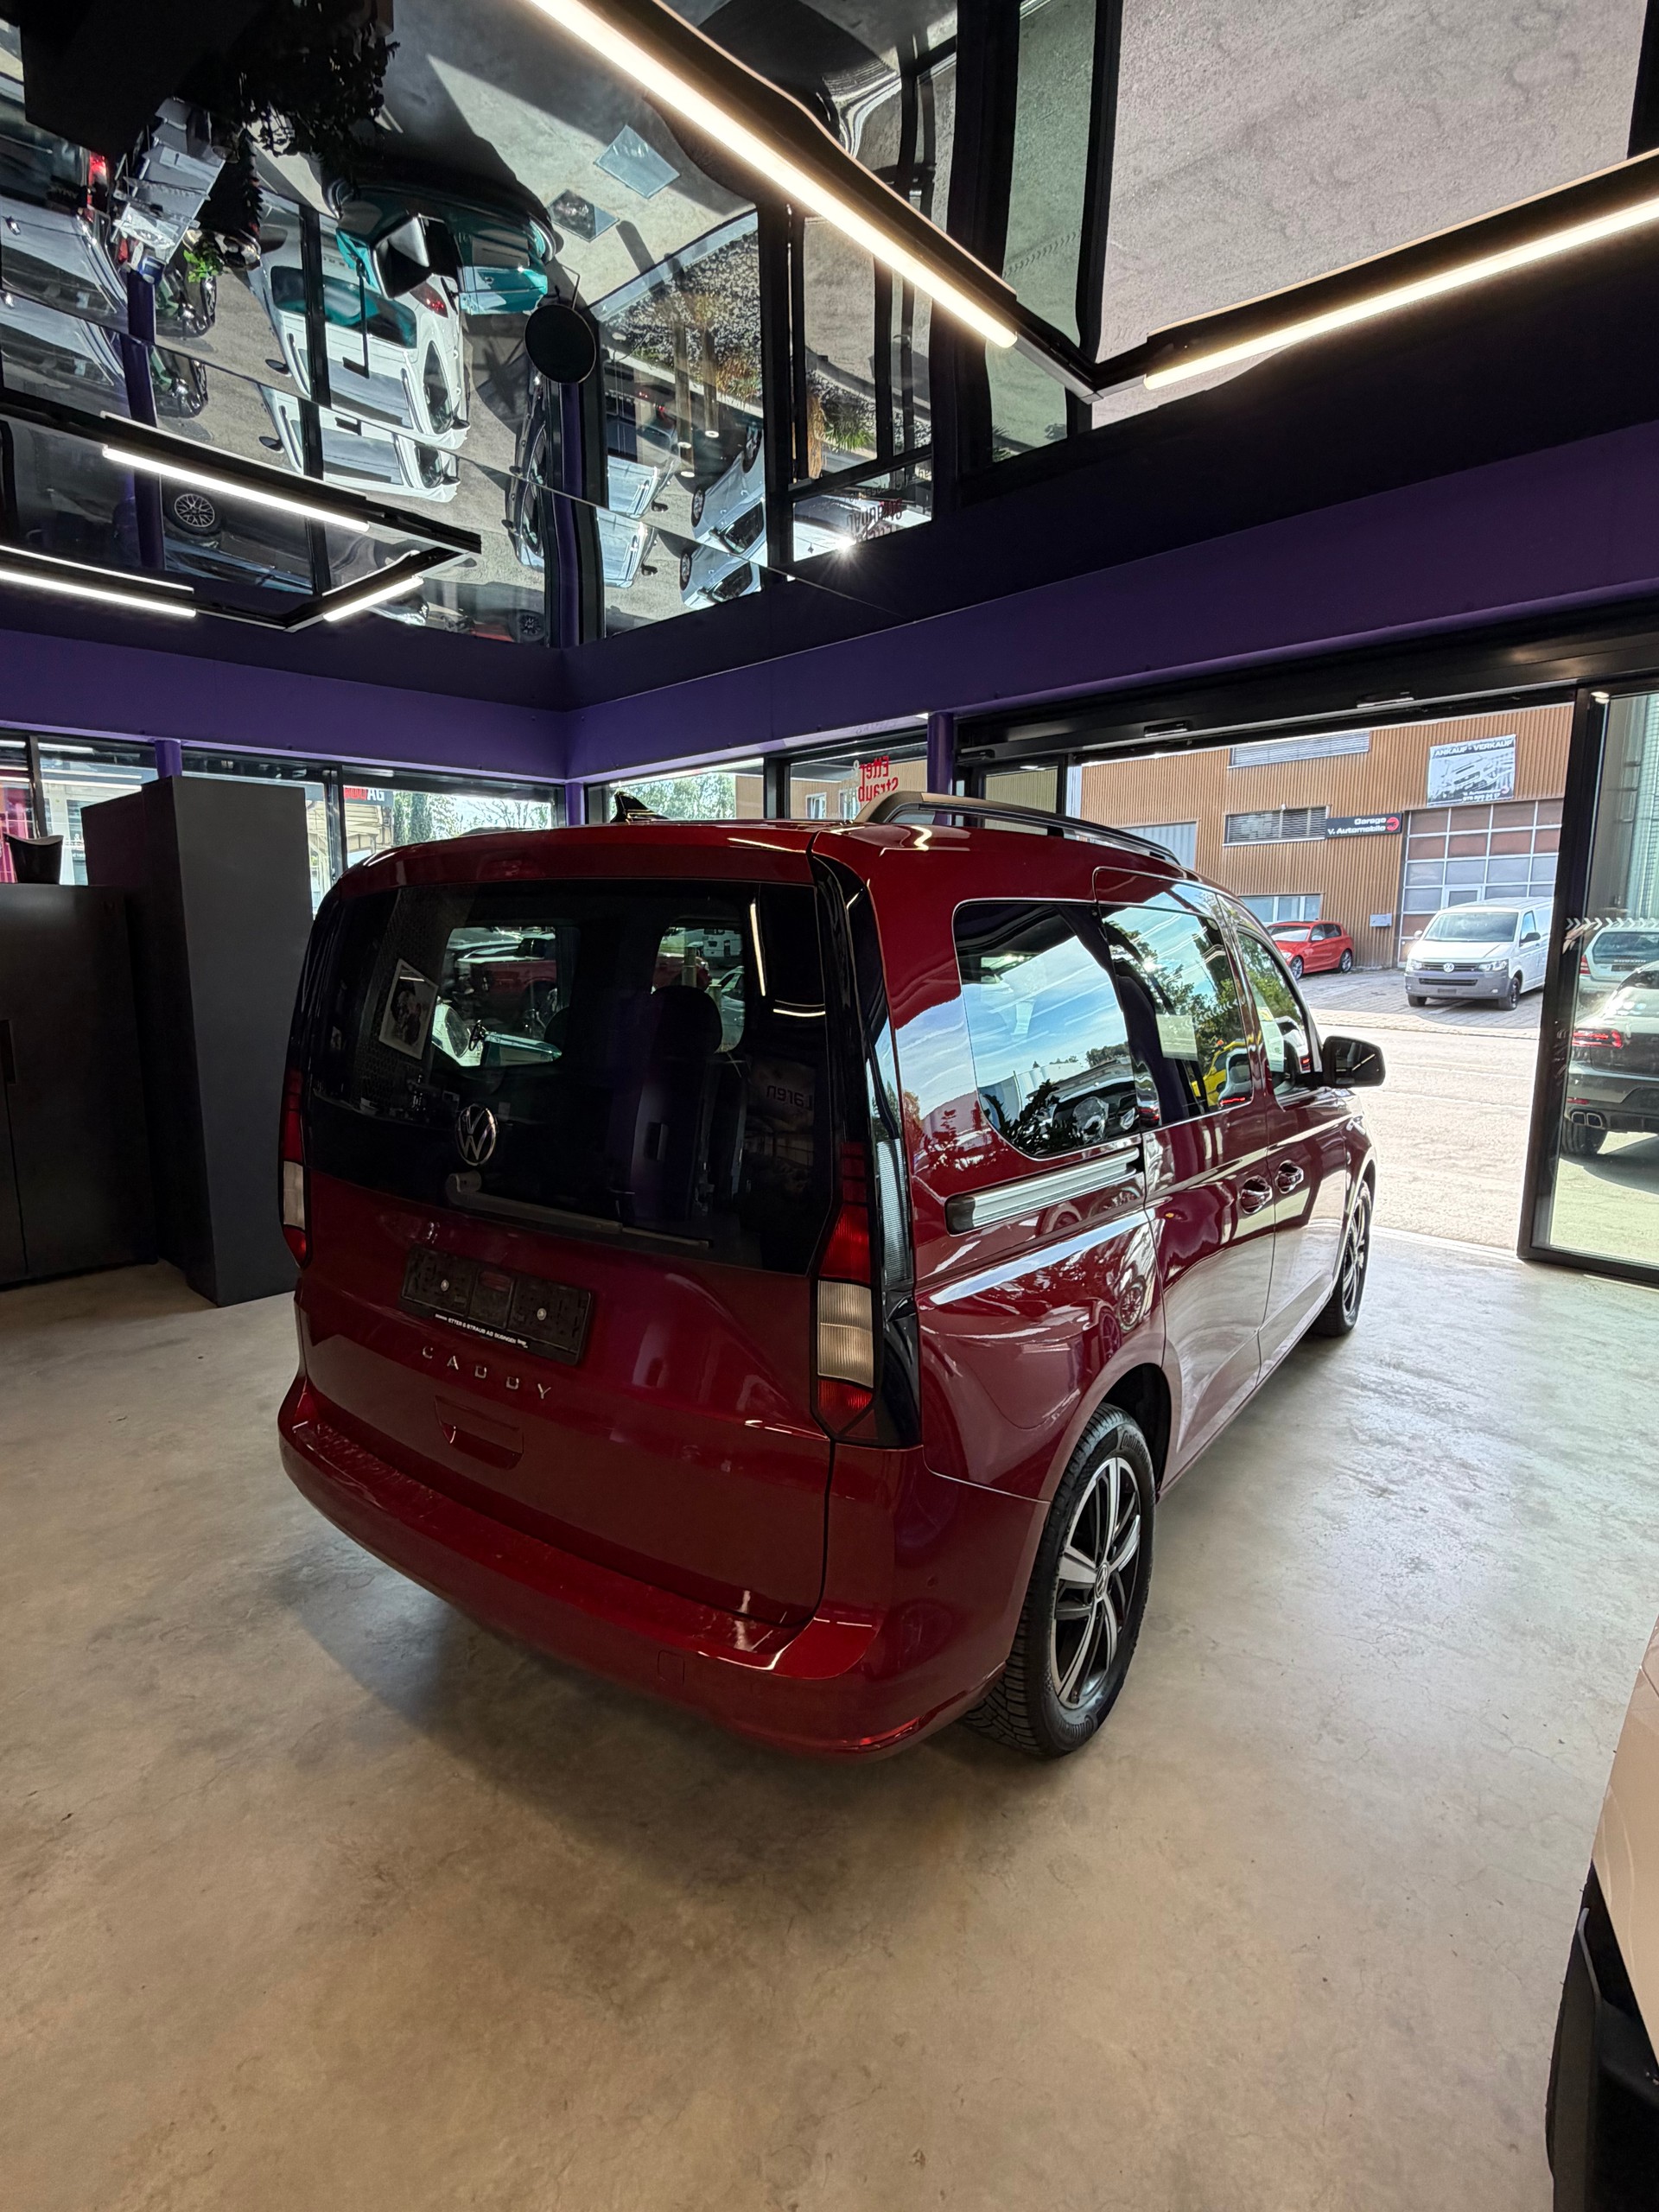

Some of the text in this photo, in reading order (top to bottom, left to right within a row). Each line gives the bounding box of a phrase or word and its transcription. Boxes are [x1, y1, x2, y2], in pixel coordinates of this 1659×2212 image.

[1434, 747, 1467, 757] ANKAUF
[1473, 740, 1513, 752] VERKAUF
[367, 788, 385, 802] AG
[422, 1347, 551, 1399] CADDY
